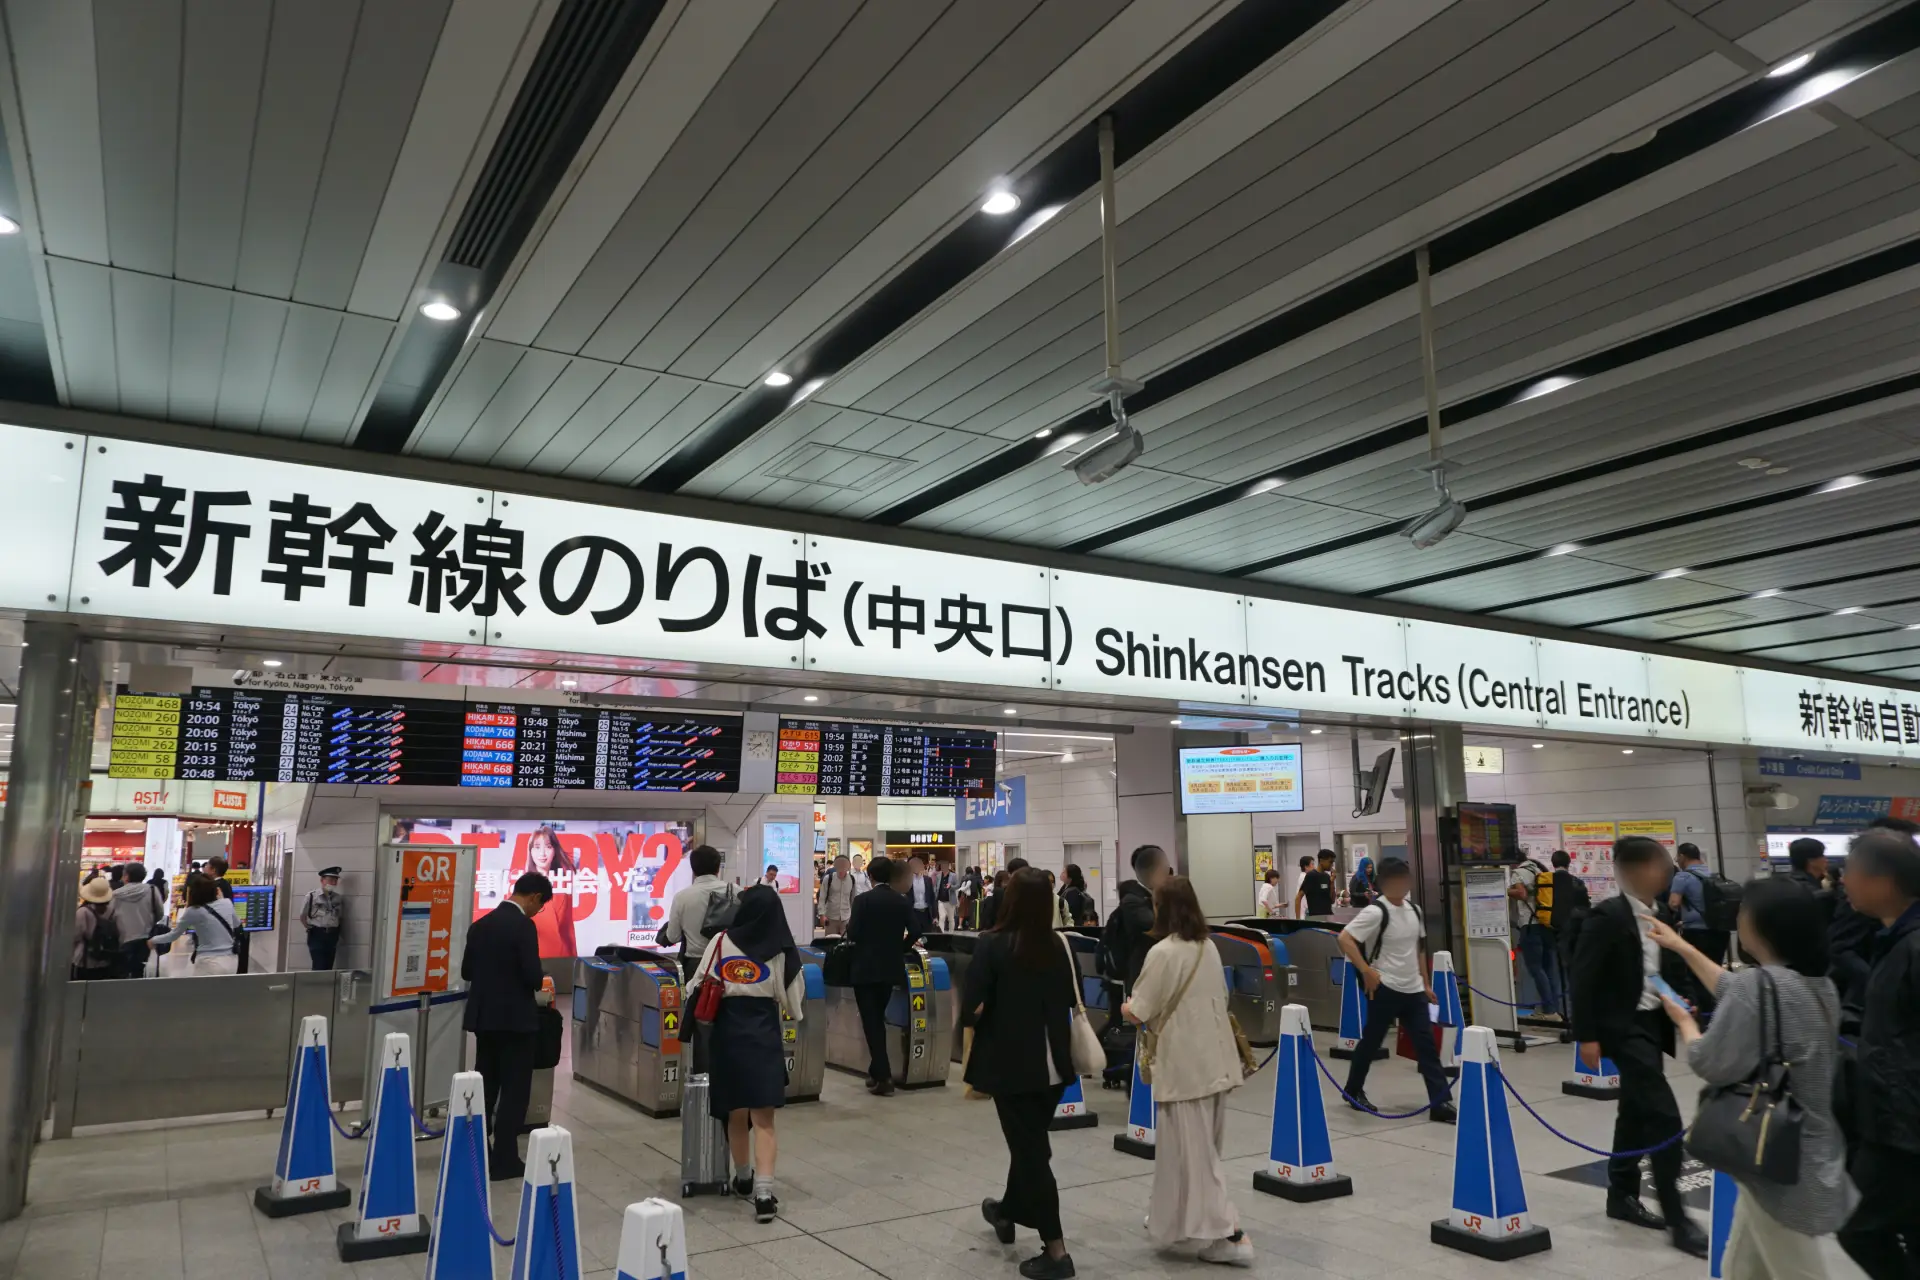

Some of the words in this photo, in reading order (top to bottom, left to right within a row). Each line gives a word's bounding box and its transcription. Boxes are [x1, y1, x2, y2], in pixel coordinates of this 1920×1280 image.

[1095, 627, 1326, 693] Shinkansen
[1341, 655, 1451, 705] Tracks
[1458, 663, 1566, 715] (Central
[1577, 682, 1690, 729] Entrance)
[156, 700, 178, 708] 468
[189, 701, 221, 711] 19:54
[286, 706, 296, 715] 24
[116, 710, 152, 718] NOZOMI
[155, 714, 177, 722] 260
[187, 714, 220, 725] 20:00
[285, 719, 295, 728] 25
[498, 716, 515, 725] 522
[523, 718, 548, 726] 19:48
[600, 721, 608, 730] 25
[115, 724, 151, 732] NOZOMI
[158, 727, 172, 736] 56
[186, 728, 218, 738] 20:06
[284, 732, 294, 741] 25
[497, 728, 514, 737] 760
[522, 730, 546, 738] 19:51
[598, 733, 607, 741] 27
[805, 731, 819, 739] 615
[114, 738, 149, 746] NOZOMI
[152, 741, 174, 749] 262
[185, 741, 217, 751] 20:15
[283, 745, 293, 754] 27
[496, 741, 514, 749] 666
[521, 742, 545, 750] 20:21
[598, 744, 606, 753] 24
[804, 742, 818, 750] 521
[112, 752, 148, 760] NOZOMI
[156, 755, 170, 763] 58
[183, 755, 216, 765] 20:33
[281, 758, 292, 767] 27
[495, 753, 512, 761] 762
[520, 754, 545, 763] 20:42
[597, 756, 605, 765] 23
[824, 754, 843, 762] 20:02
[154, 768, 168, 777] 60
[182, 769, 215, 778] 20:48
[280, 771, 291, 780] 26
[494, 765, 512, 773] 668
[519, 766, 544, 774] 20:45
[596, 768, 605, 776] 24
[493, 777, 511, 786] 764
[518, 778, 543, 786] 21:03
[595, 780, 604, 788] 23
[134, 792, 169, 805] ASTY
[217, 796, 243, 807] PLUSTA
[417, 855, 449, 882] QR
[630, 932, 656, 943] Ready
[1267, 1001, 1274, 1012] 5
[914, 1045, 924, 1059] 9
[663, 1067, 678, 1083] 11
[1581, 1076, 1593, 1085] JR
[1608, 1076, 1618, 1086] JR
[1062, 1104, 1076, 1114] JR
[1135, 1128, 1145, 1138] JR
[1277, 1165, 1292, 1177] JR
[1311, 1166, 1325, 1178] JR
[300, 1179, 320, 1192] JR
[378, 1218, 401, 1233] JR
[1463, 1215, 1482, 1230] JR
[1506, 1217, 1521, 1232] JR
